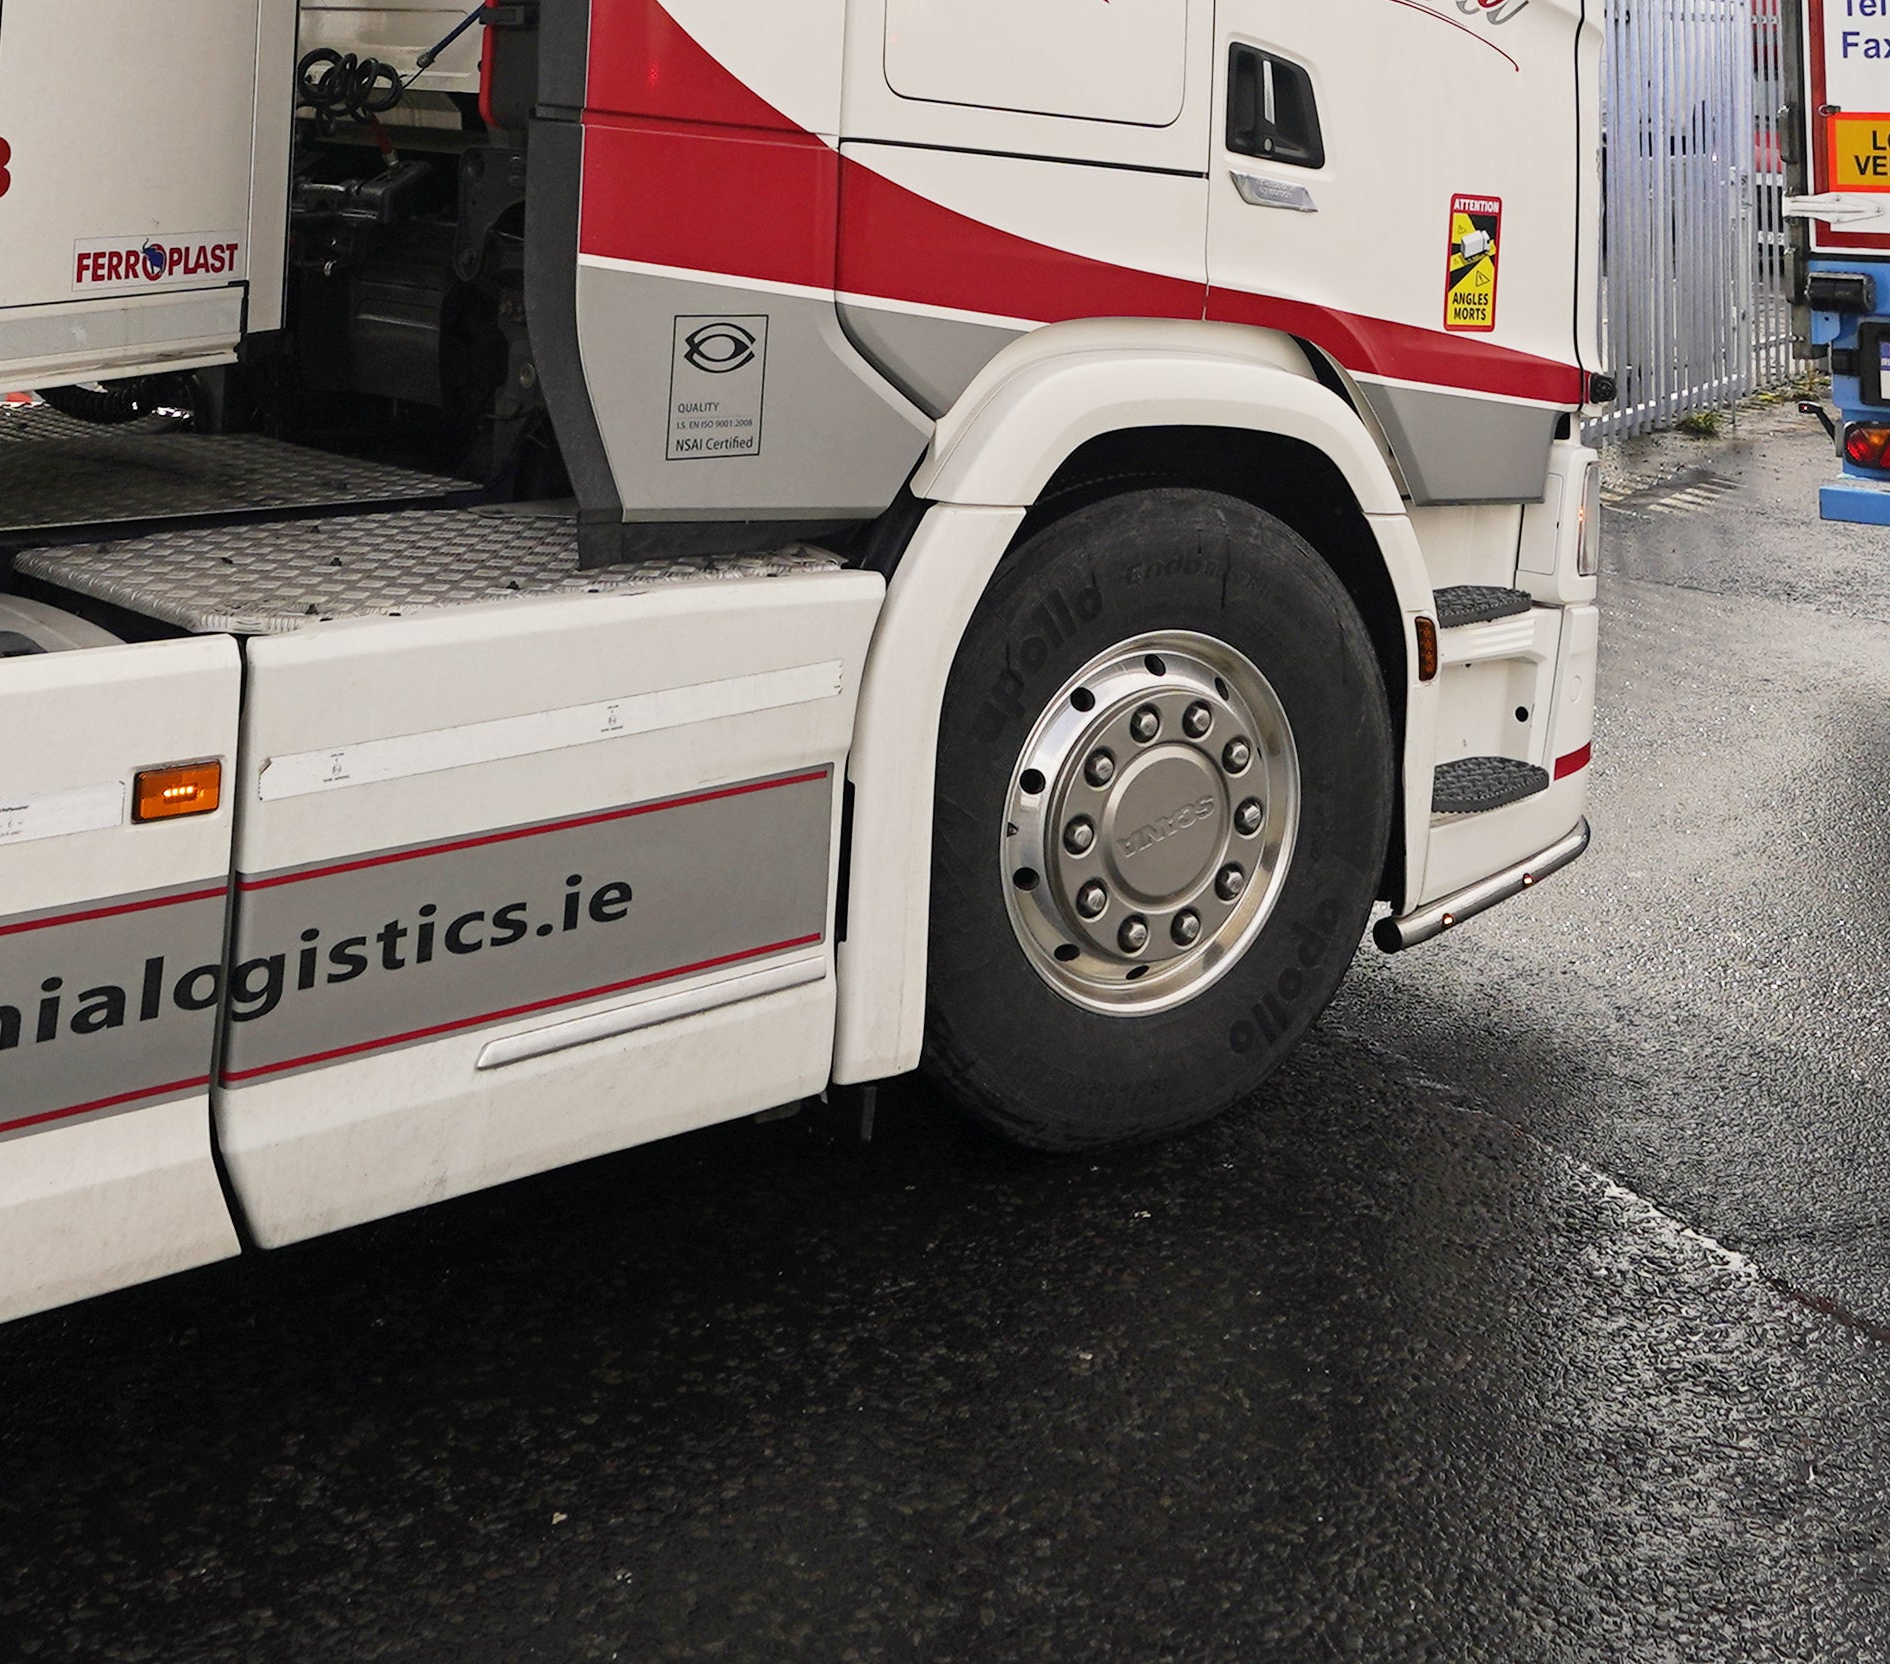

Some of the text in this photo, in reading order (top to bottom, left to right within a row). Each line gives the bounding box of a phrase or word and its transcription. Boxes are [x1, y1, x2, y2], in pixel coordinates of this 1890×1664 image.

[1453, 197, 1500, 213] ATTENTION
[75, 240, 240, 285] FERROPLAST
[1452, 292, 1489, 306] ANGLES
[1453, 307, 1487, 321] MORTS
[677, 401, 720, 414] QUALITY
[689, 420, 701, 429] EN
[675, 436, 754, 452] NSAI Certified
